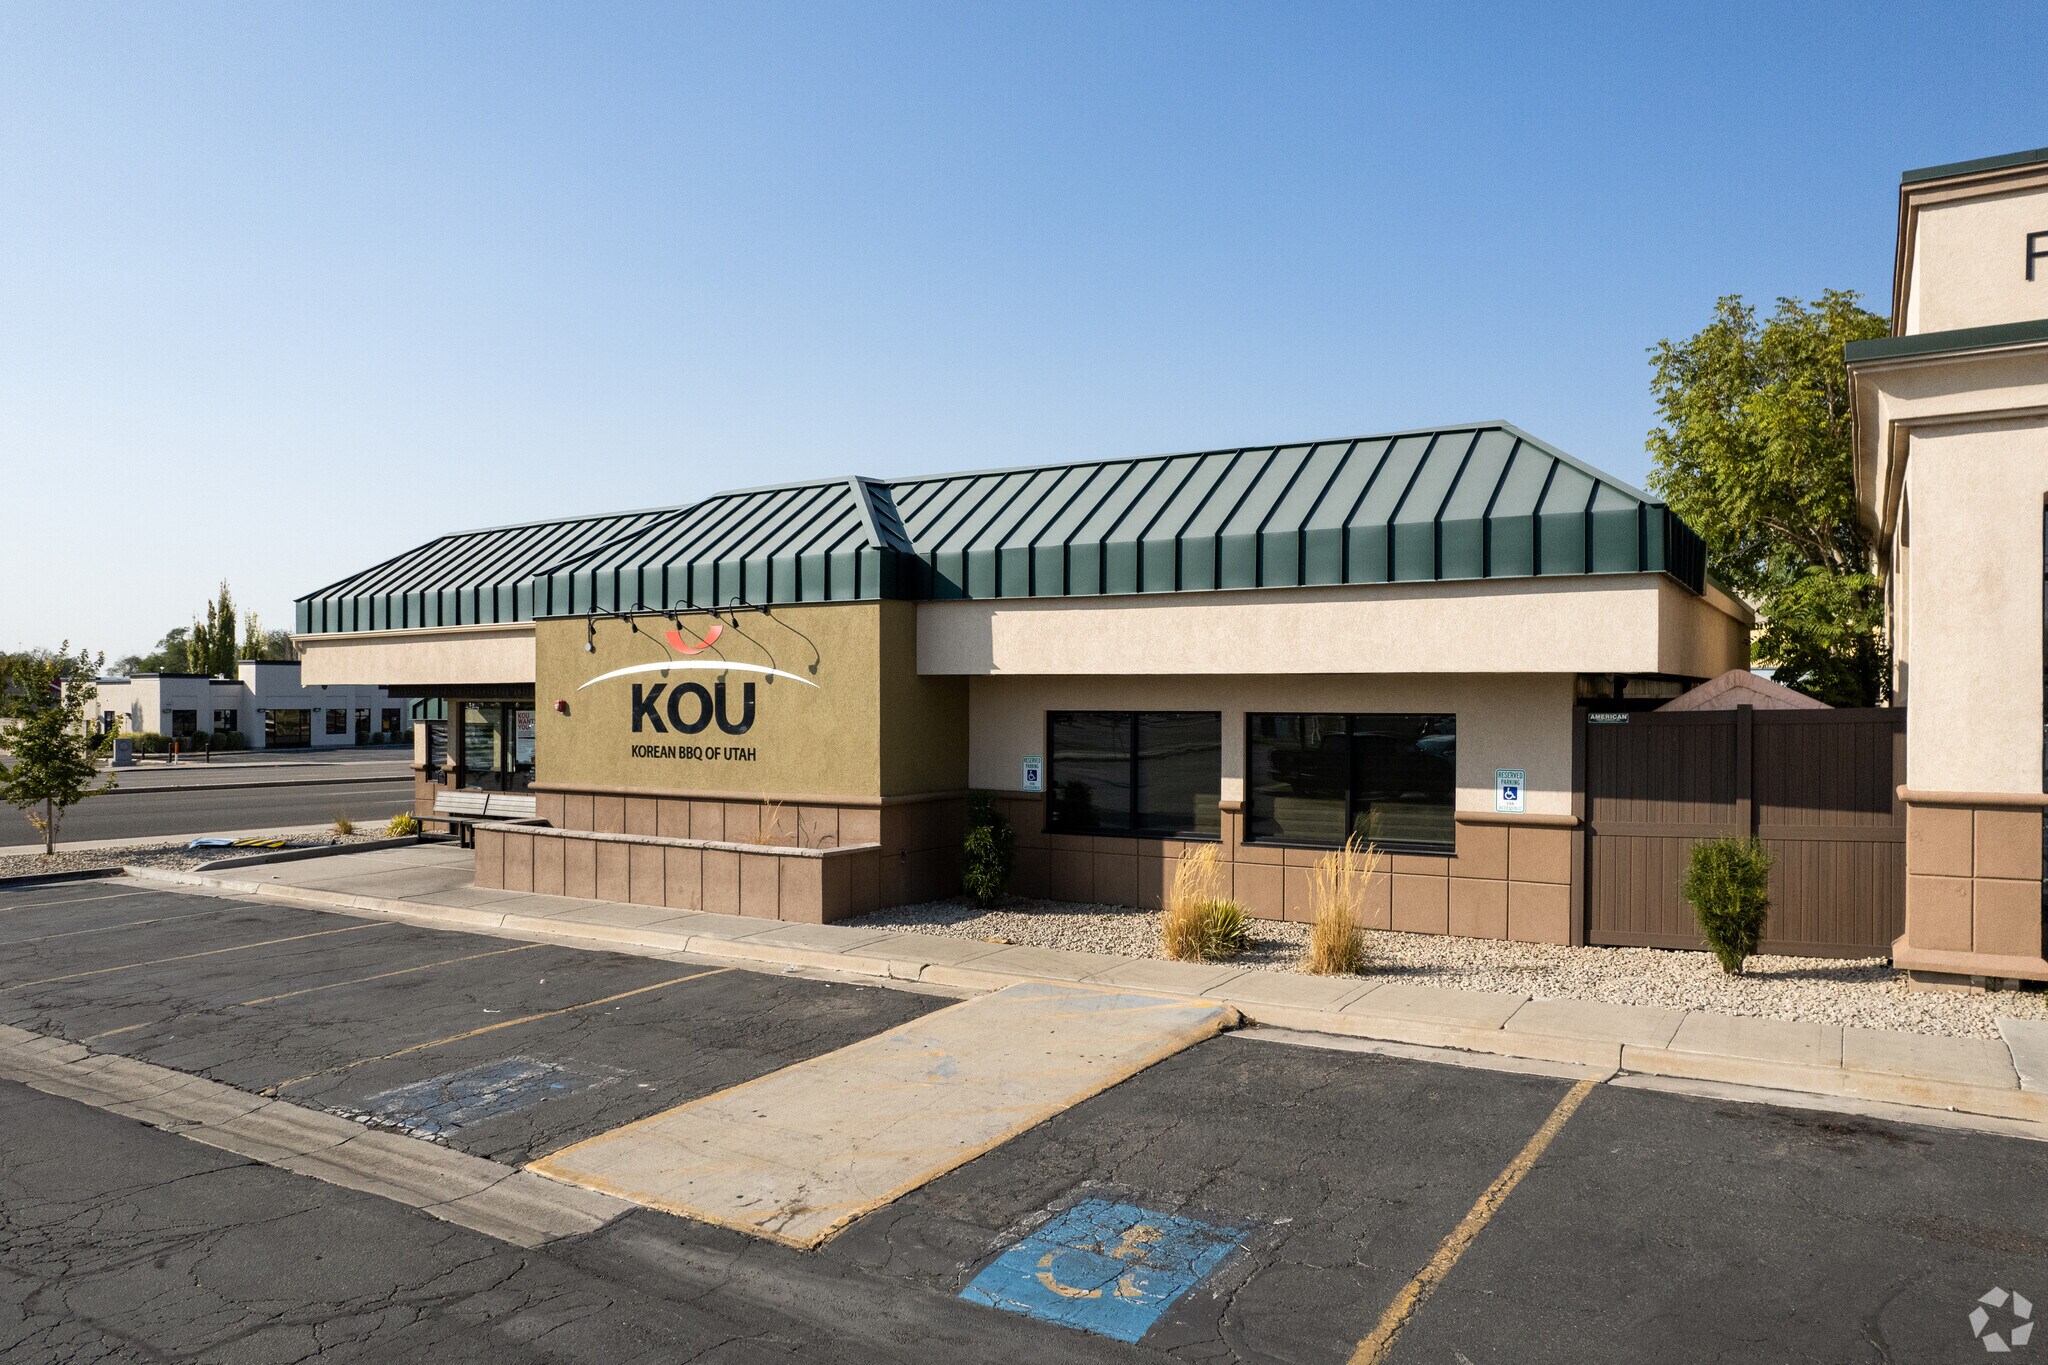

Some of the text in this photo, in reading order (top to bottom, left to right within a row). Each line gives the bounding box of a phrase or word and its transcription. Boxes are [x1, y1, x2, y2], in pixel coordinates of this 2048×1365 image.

[632, 682, 756, 736] KOU
[631, 745, 757, 761] KOREAN BBQ OF UTAH
